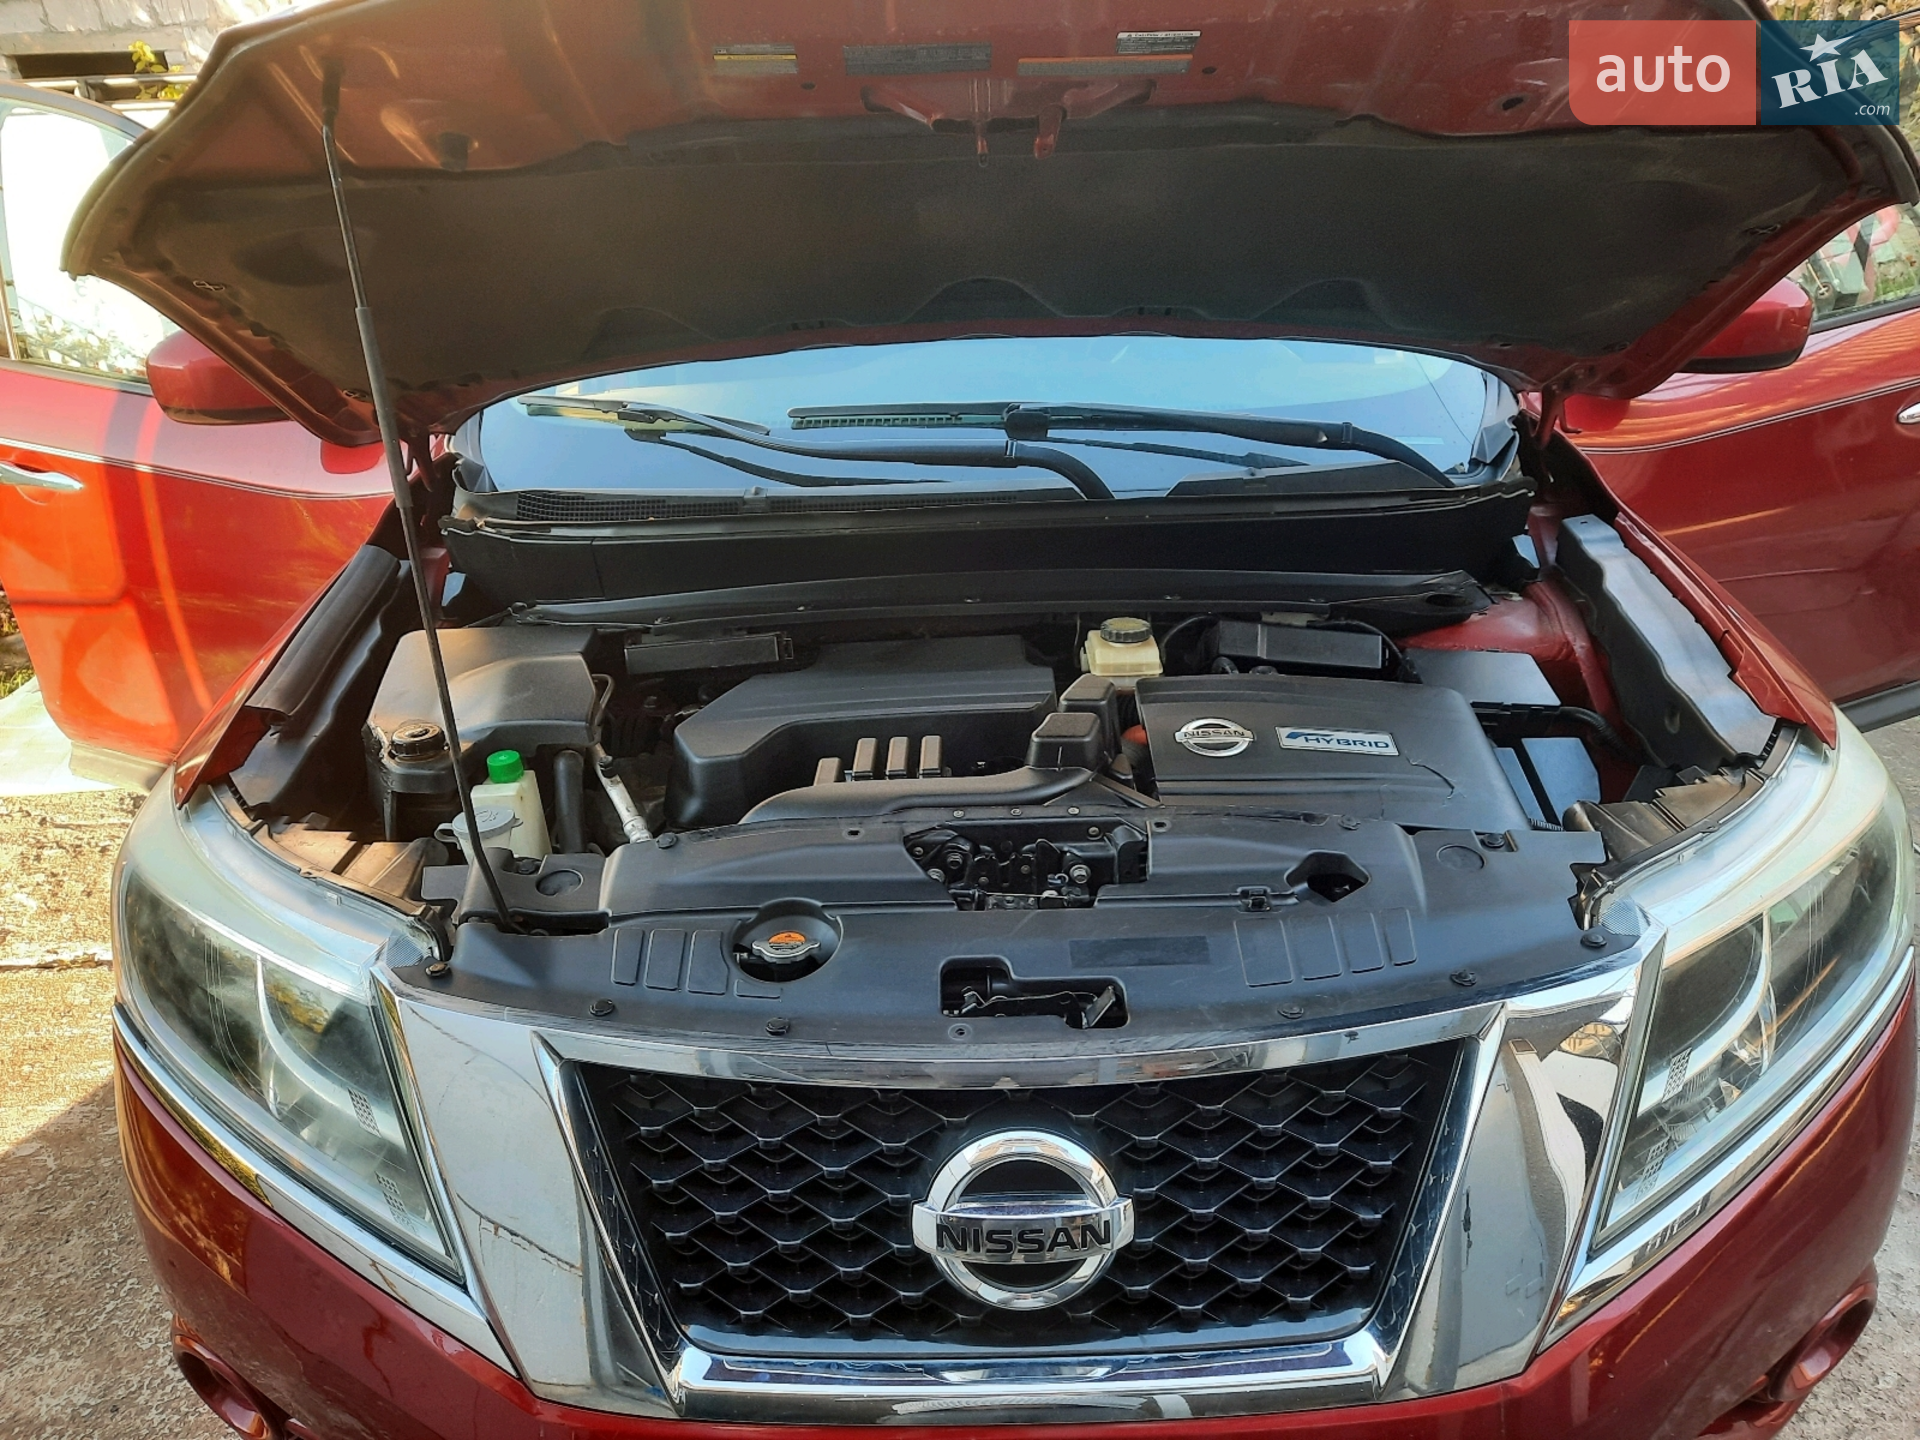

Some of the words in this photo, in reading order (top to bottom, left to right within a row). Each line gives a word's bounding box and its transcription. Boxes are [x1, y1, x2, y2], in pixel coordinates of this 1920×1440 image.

[1183, 729, 1245, 739] NISSAN
[1303, 735, 1390, 749] HYBRID
[936, 1219, 1112, 1255] NISSAN
